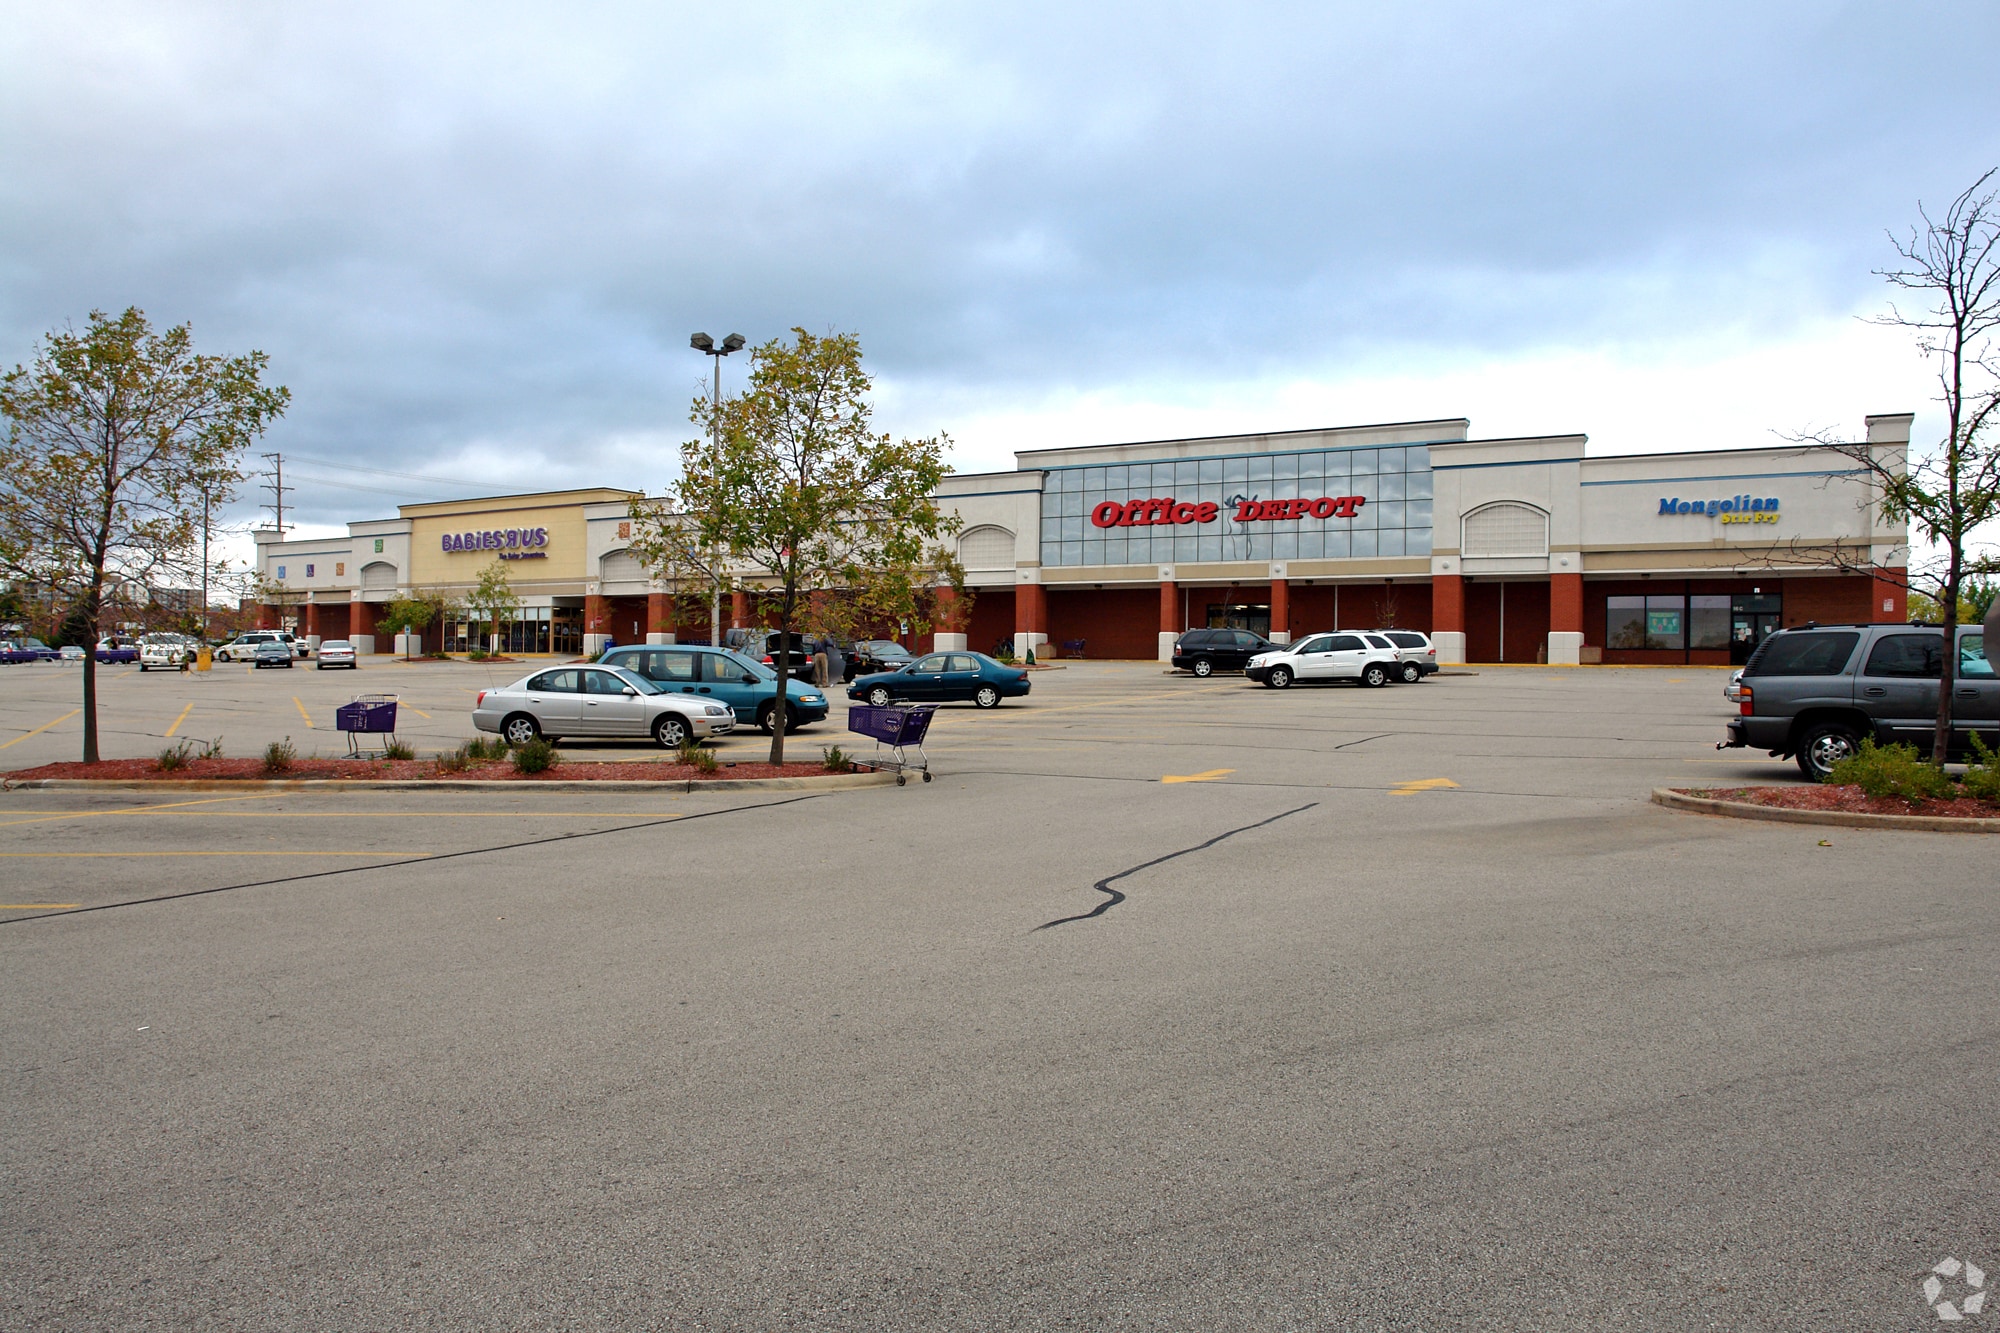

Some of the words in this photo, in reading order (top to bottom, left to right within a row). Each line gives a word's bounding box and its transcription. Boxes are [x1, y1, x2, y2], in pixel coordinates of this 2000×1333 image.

[1091, 497, 1219, 528] Office
[1233, 495, 1366, 522] DEPOT
[1658, 495, 1779, 517] Mongolian
[1721, 512, 1751, 524] Stir
[1752, 511, 1780, 524] Fry
